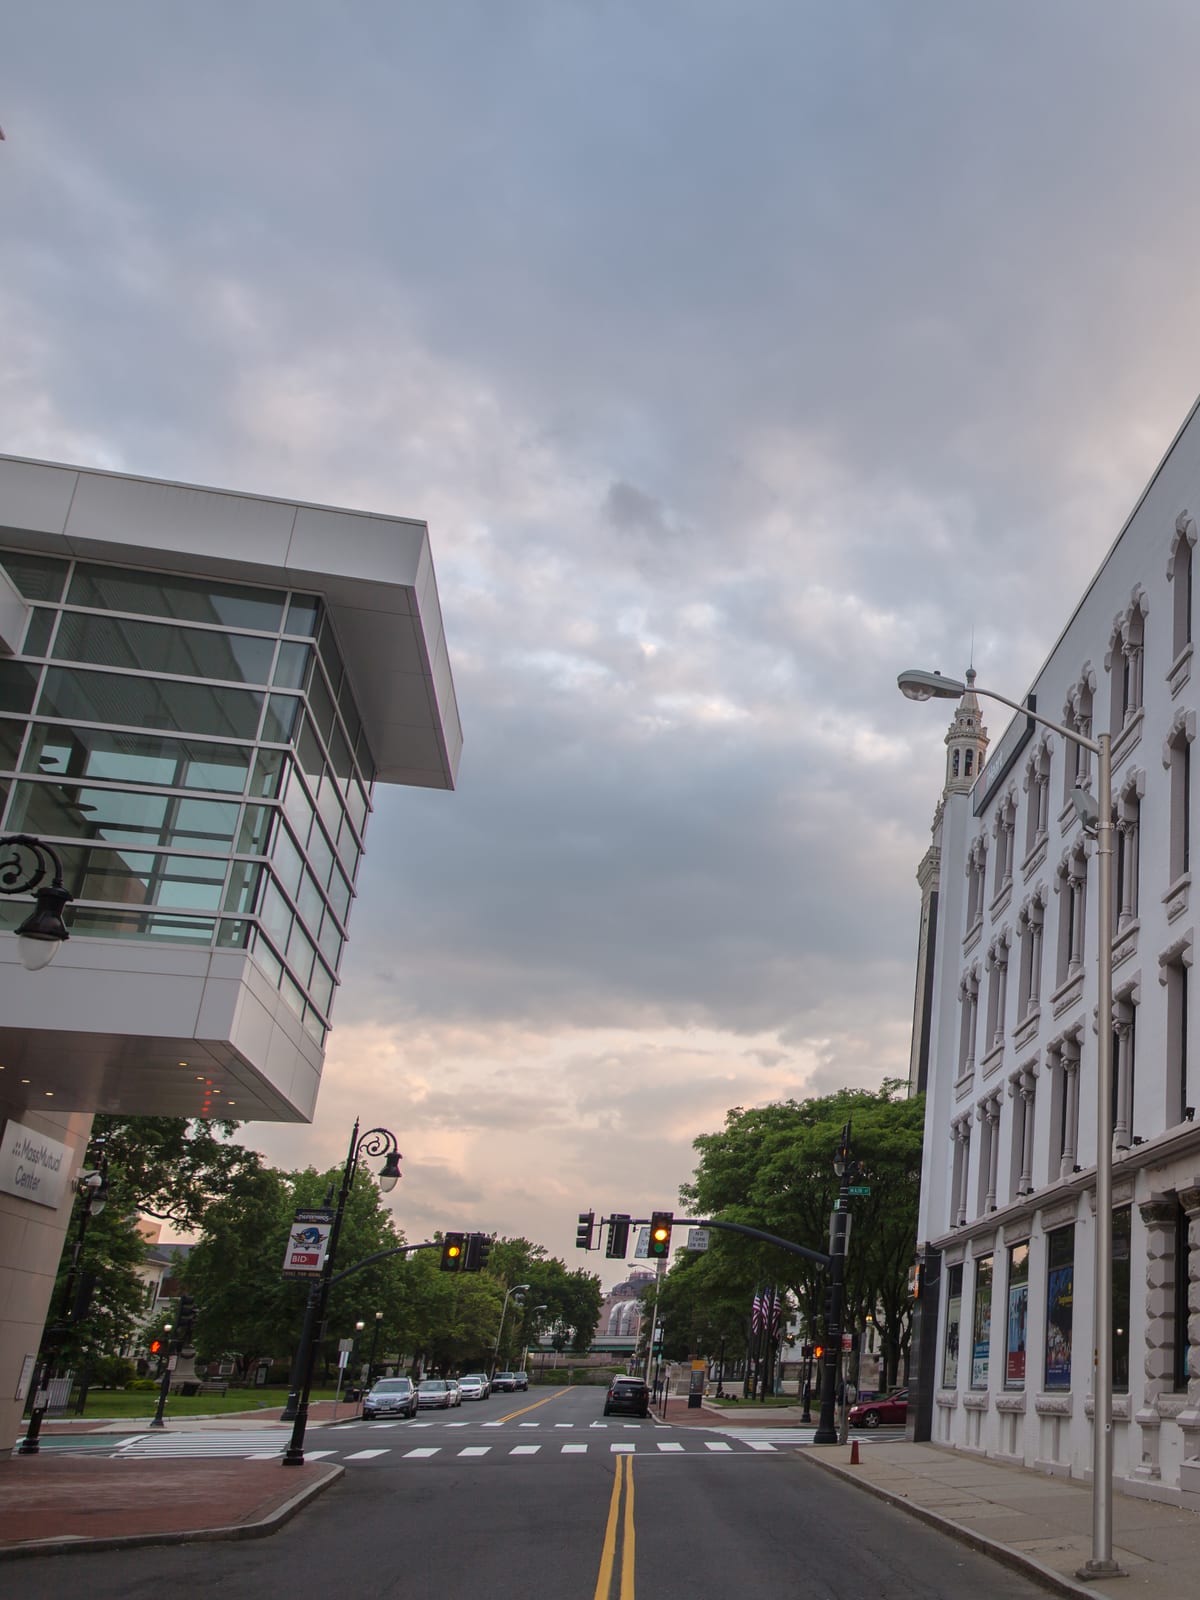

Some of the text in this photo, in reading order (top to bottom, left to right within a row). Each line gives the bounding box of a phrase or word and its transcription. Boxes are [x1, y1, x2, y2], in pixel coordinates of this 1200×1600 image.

[20, 1136, 64, 1173] MassMutual
[15, 1164, 41, 1191] Center
[292, 1255, 307, 1263] BID
